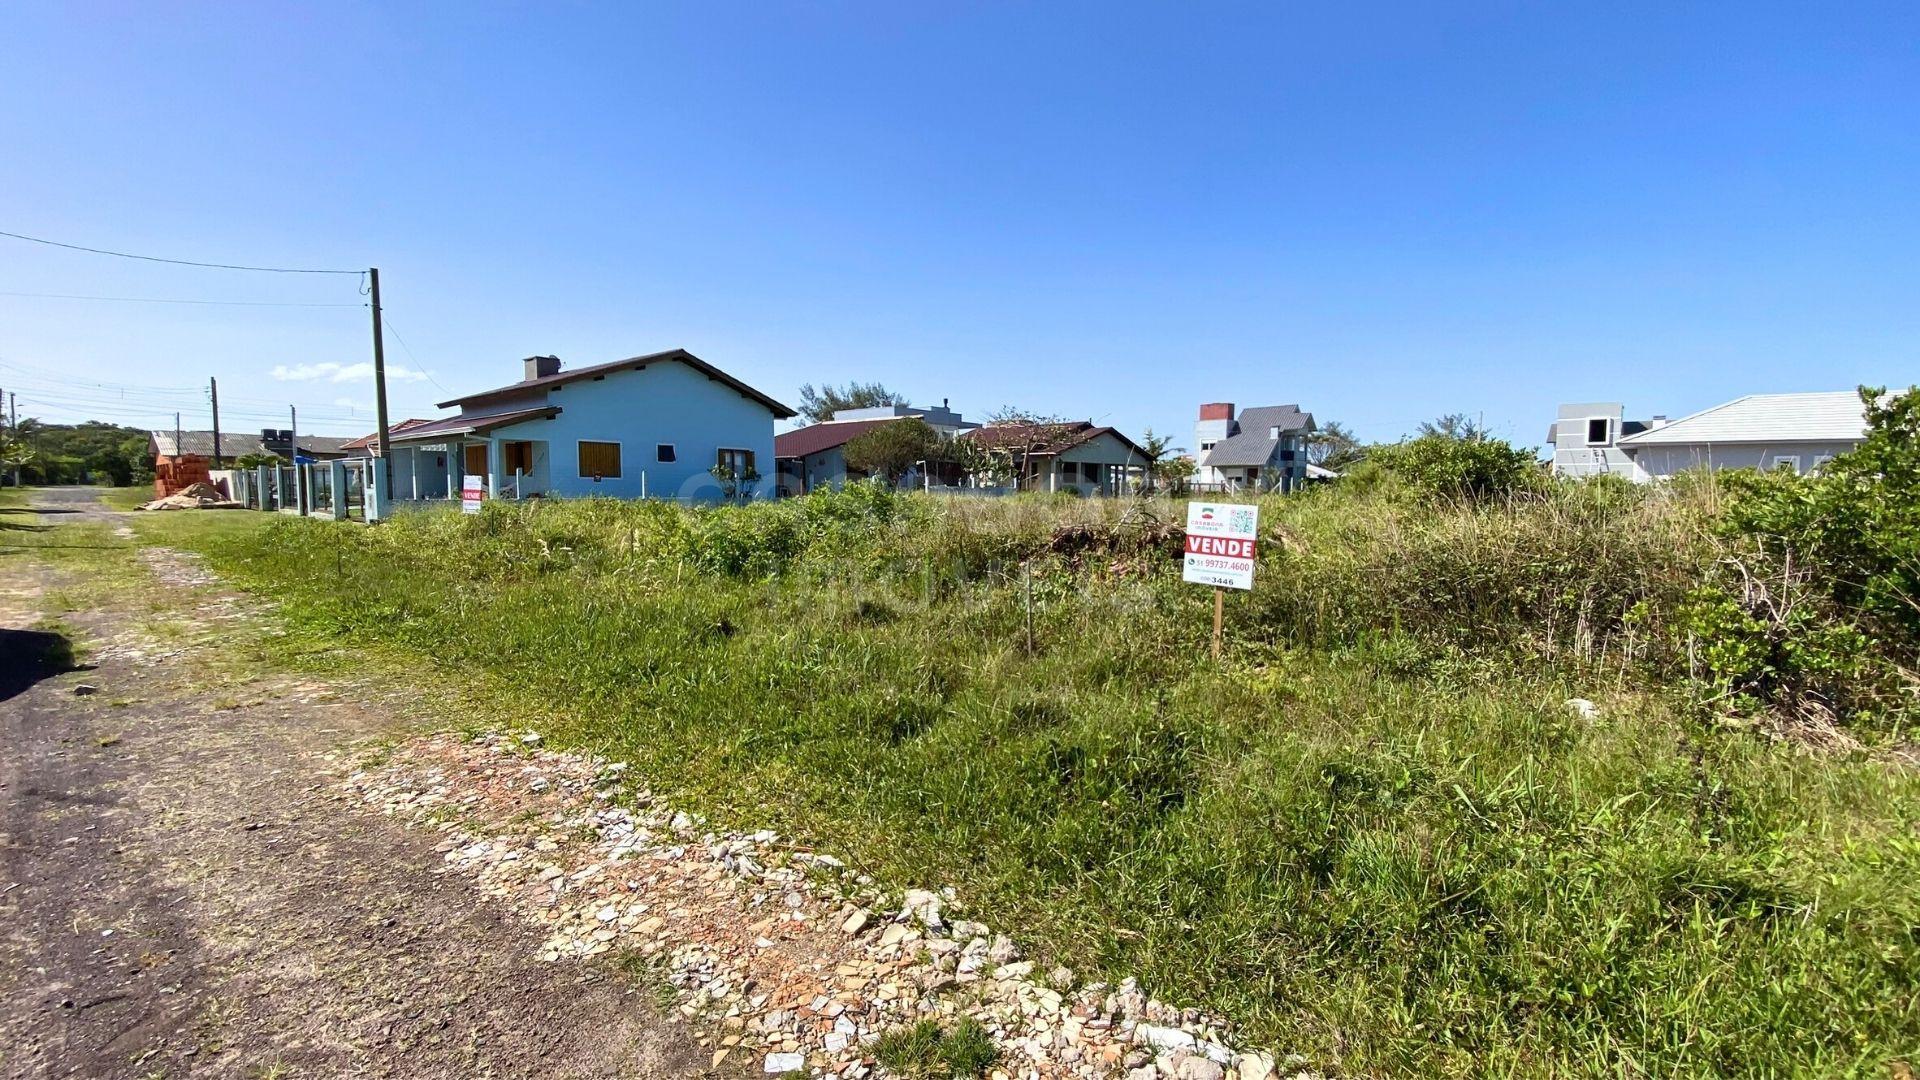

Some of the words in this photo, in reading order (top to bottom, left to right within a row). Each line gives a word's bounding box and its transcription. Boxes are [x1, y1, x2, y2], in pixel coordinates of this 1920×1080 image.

[1188, 536, 1252, 557] VENDE
[1205, 560, 1249, 571] 99737.4600
[1212, 577, 1234, 585] 3446
